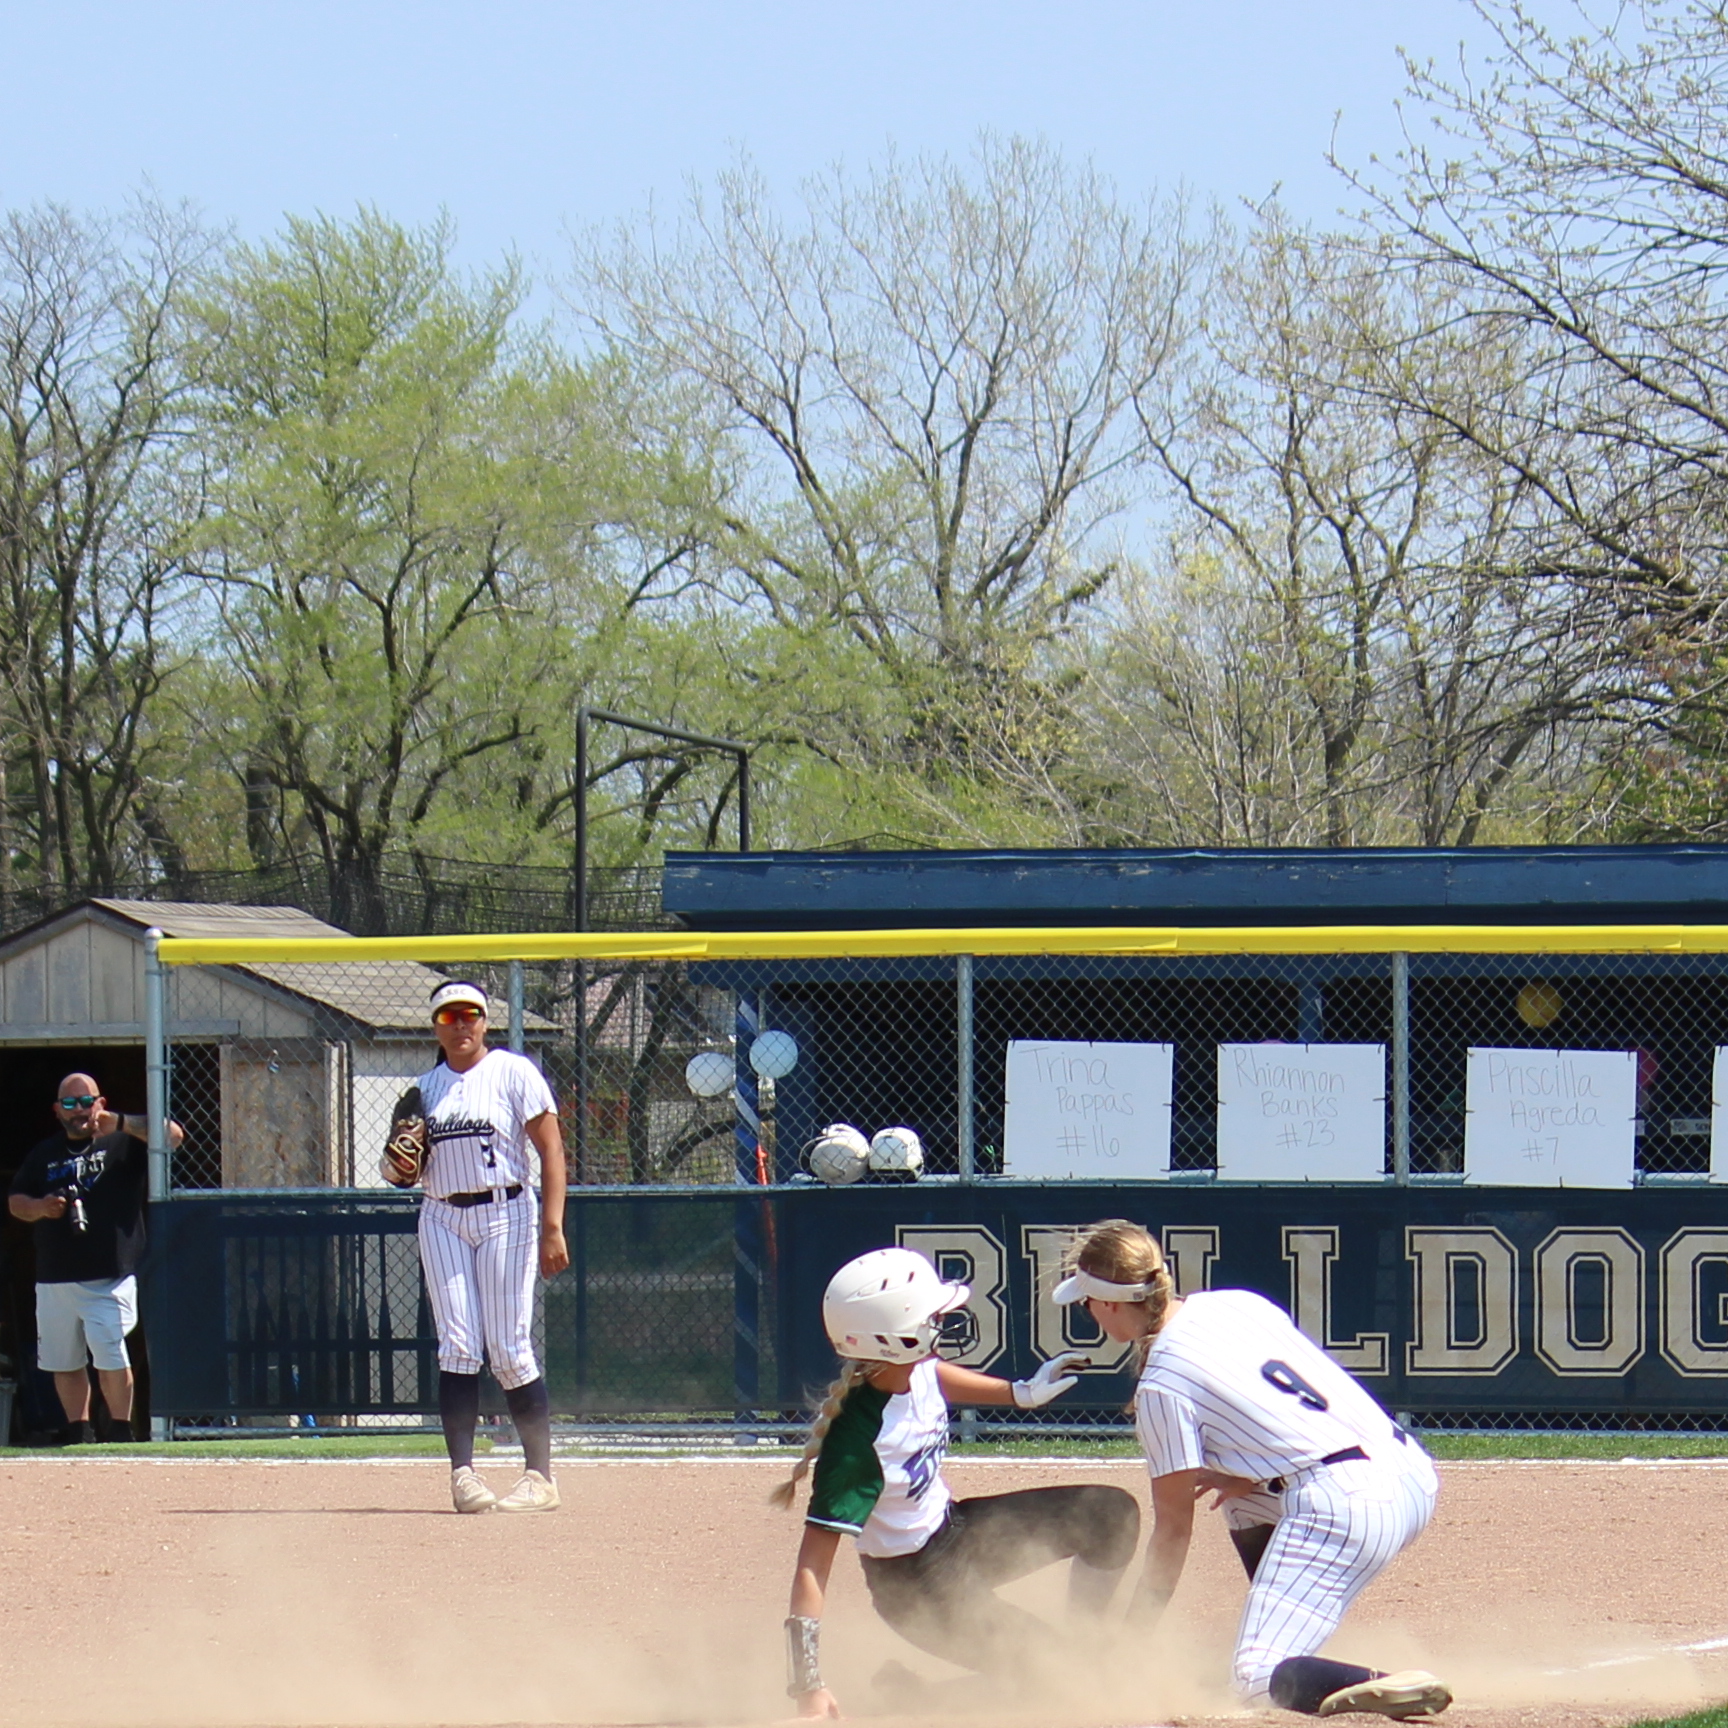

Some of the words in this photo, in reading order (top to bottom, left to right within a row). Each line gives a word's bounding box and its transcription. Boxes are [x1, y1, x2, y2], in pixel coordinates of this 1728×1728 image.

[1019, 1046, 1115, 1090] Trina
[1233, 1047, 1345, 1094] Rhiannon
[1488, 1052, 1601, 1098] Priscilla
[1056, 1085, 1134, 1122] Pappas
[1260, 1090, 1339, 1118] Banks
[1509, 1099, 1606, 1133] Agreda
[426, 1112, 495, 1142] Bulldogs
[1056, 1124, 1120, 1157] #16
[1276, 1119, 1335, 1149] #23
[1520, 1136, 1559, 1165] #7
[1260, 1359, 1328, 1412] 9
